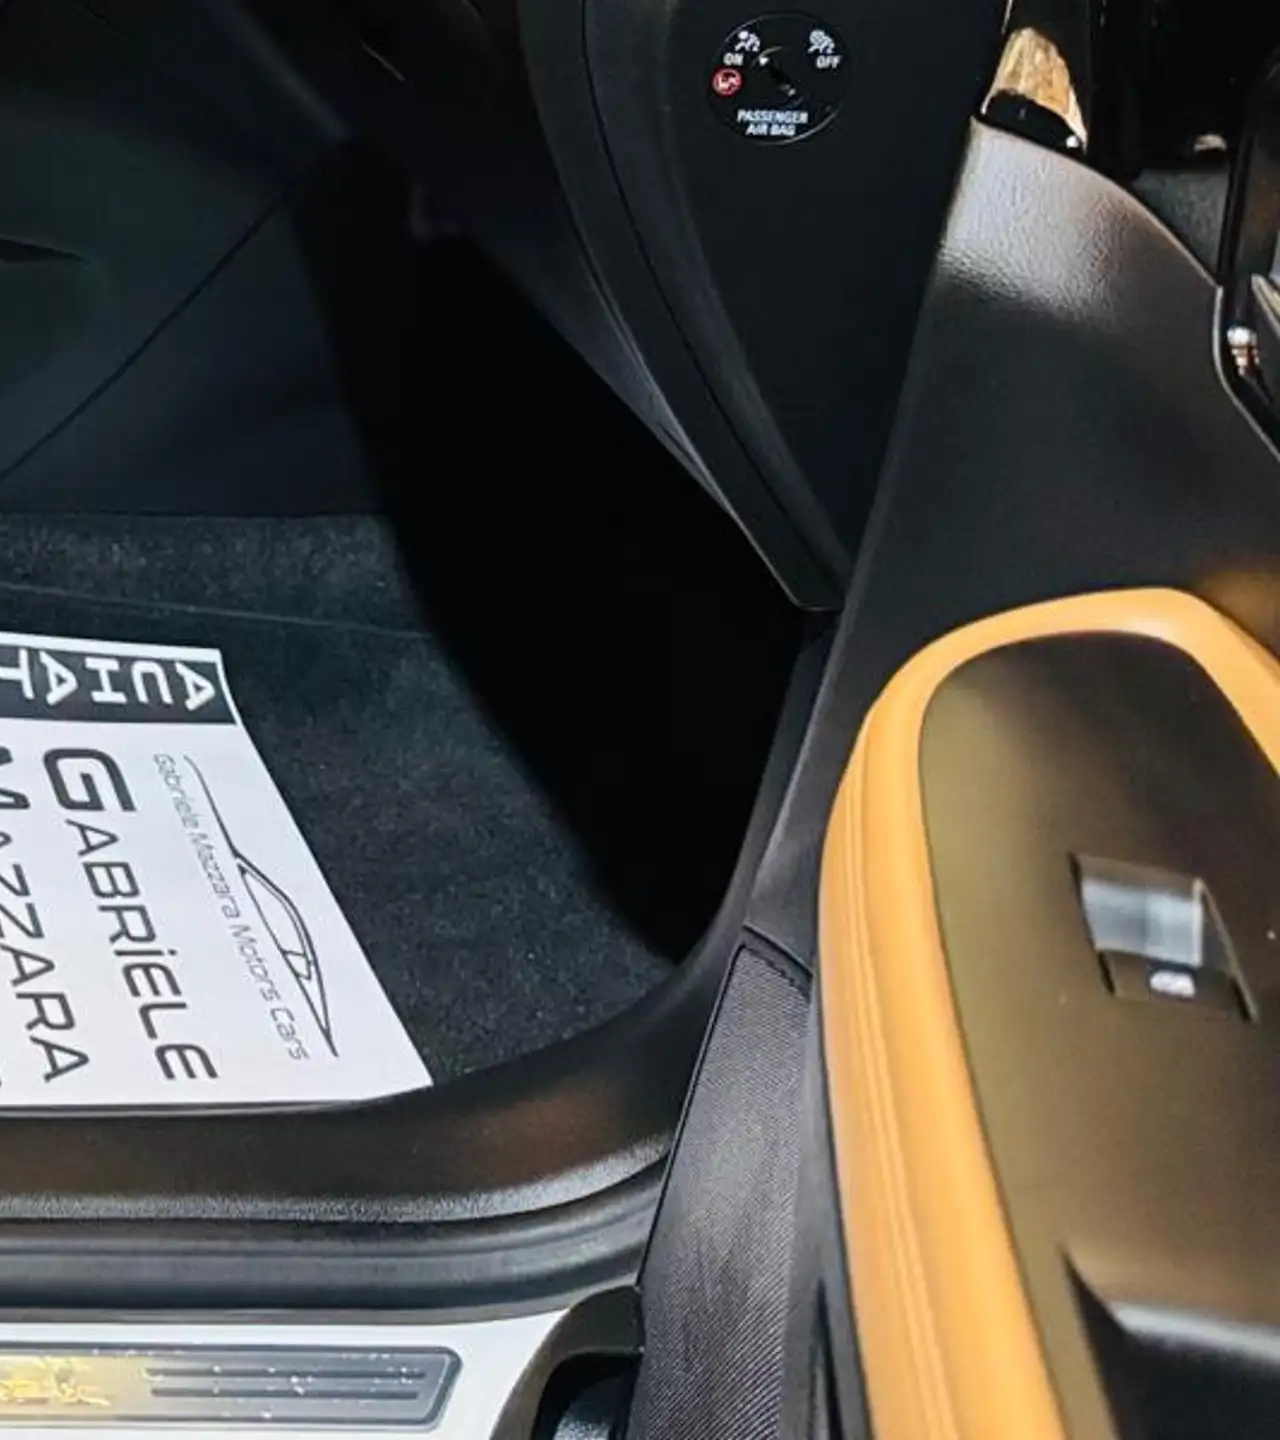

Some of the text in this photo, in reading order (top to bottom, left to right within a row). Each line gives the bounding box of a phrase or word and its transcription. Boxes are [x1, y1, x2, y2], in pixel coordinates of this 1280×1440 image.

[723, 53, 841, 69] ON OFF
[737, 109, 808, 124] PASSENGER
[746, 123, 796, 137] AIR BAG
[153, 753, 310, 1061] Gabriele Mazzara Motors Cars
